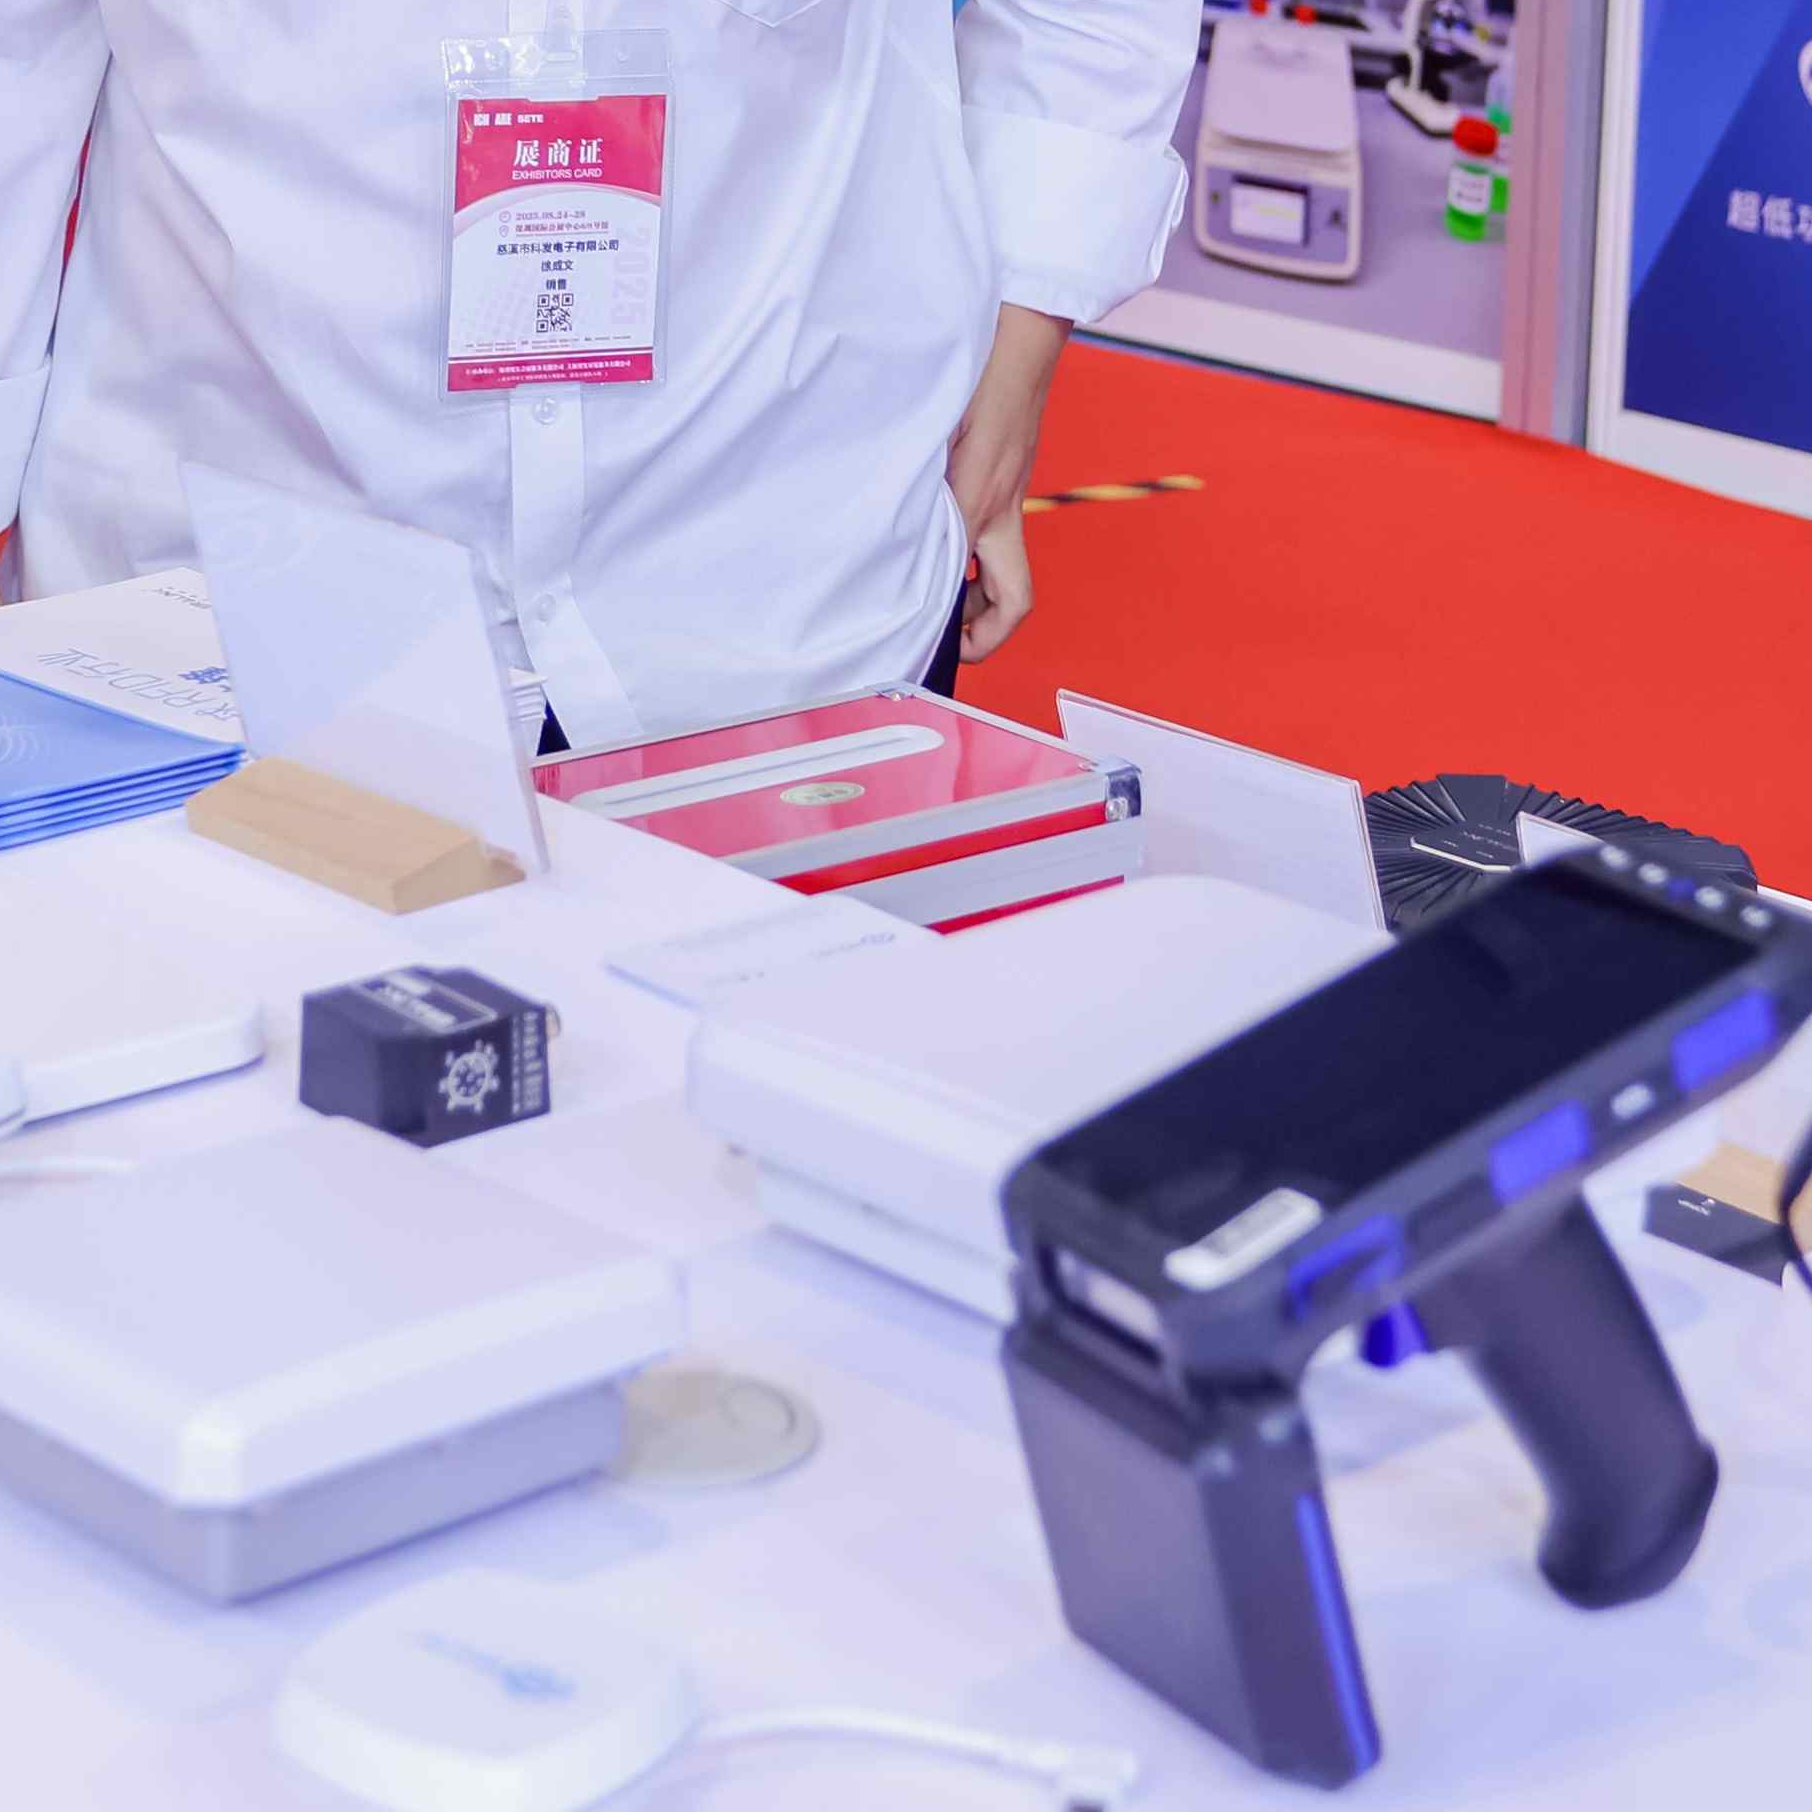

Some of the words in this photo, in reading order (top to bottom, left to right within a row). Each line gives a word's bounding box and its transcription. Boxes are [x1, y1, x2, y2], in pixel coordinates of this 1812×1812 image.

[513, 138, 603, 166] 展商证
[512, 169, 572, 180] EXHIBITORS
[574, 168, 603, 178] CARD
